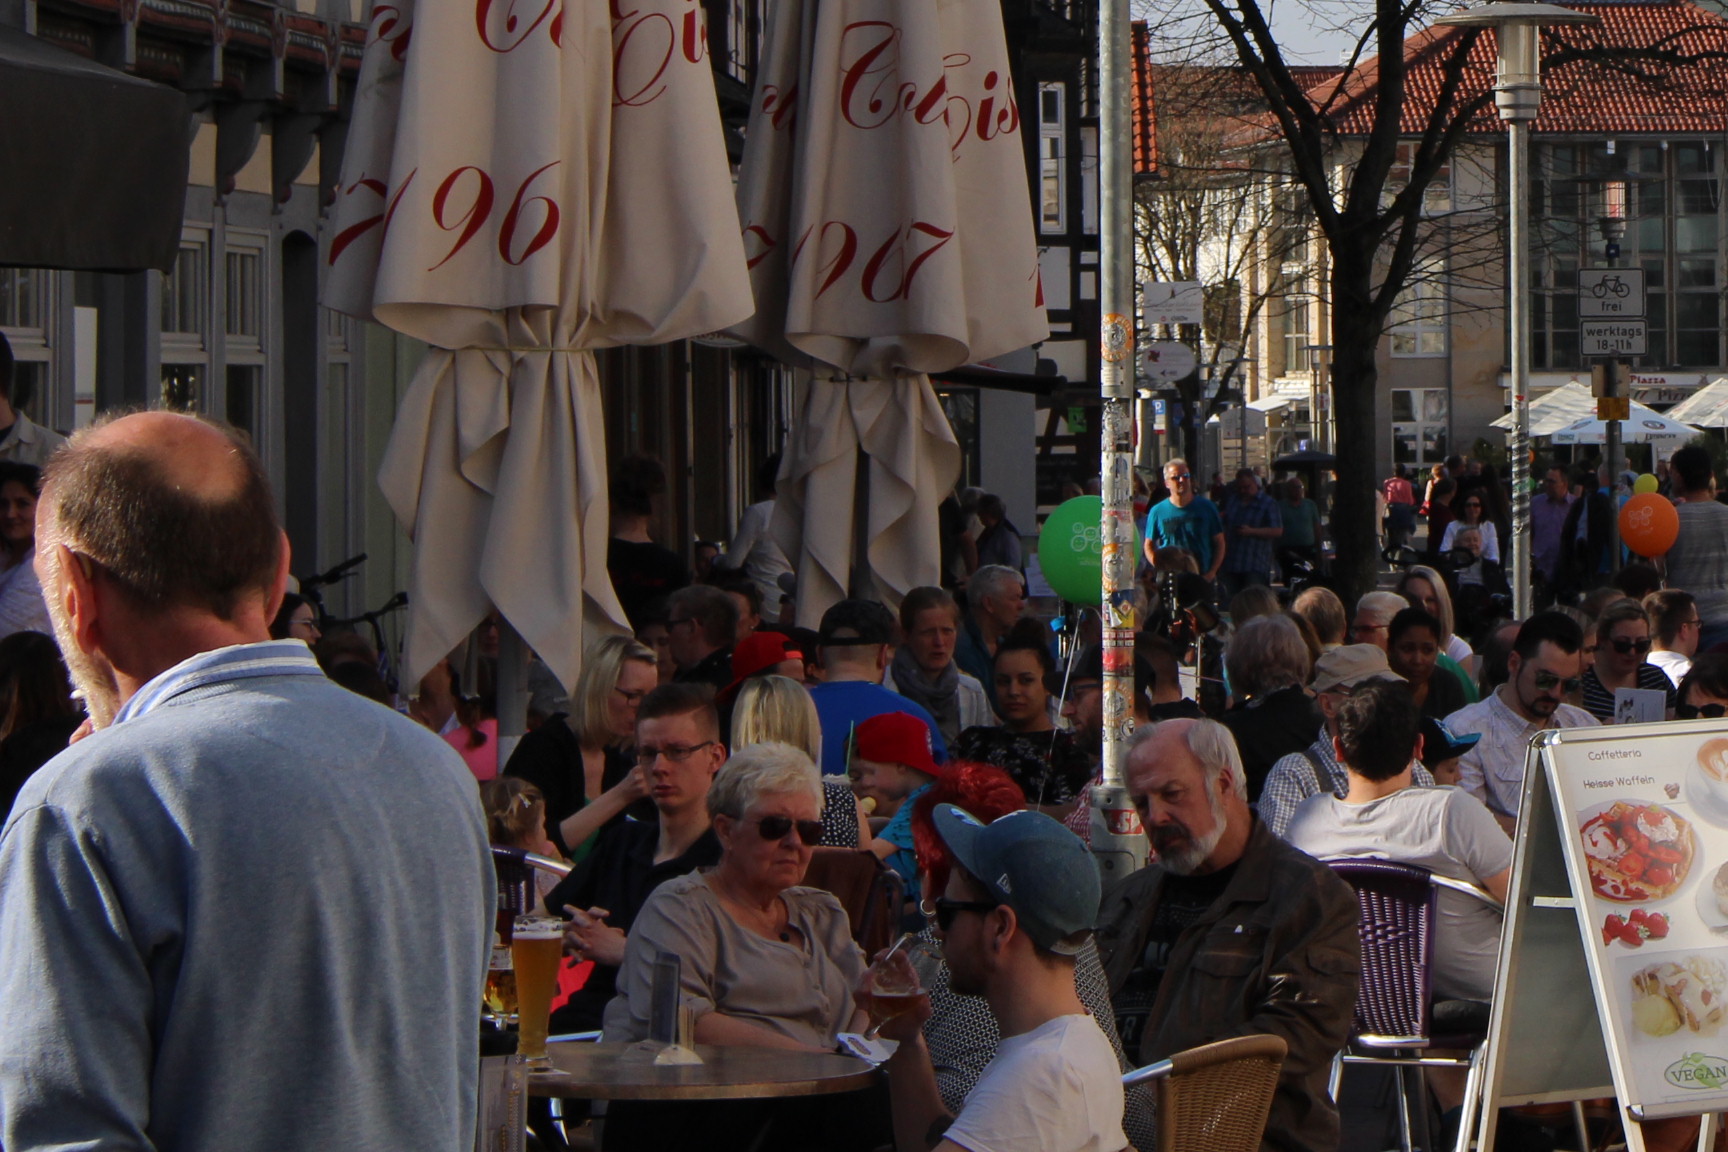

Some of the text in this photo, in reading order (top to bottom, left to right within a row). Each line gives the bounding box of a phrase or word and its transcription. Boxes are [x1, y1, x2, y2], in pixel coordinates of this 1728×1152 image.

[1601, 301, 1622, 311] frei
[1586, 326, 1642, 339] werktags
[1587, 749, 1642, 761] Caffetteria
[1583, 775, 1655, 789] Heisse Waffeln
[1671, 1066, 1727, 1082] VEGAN
